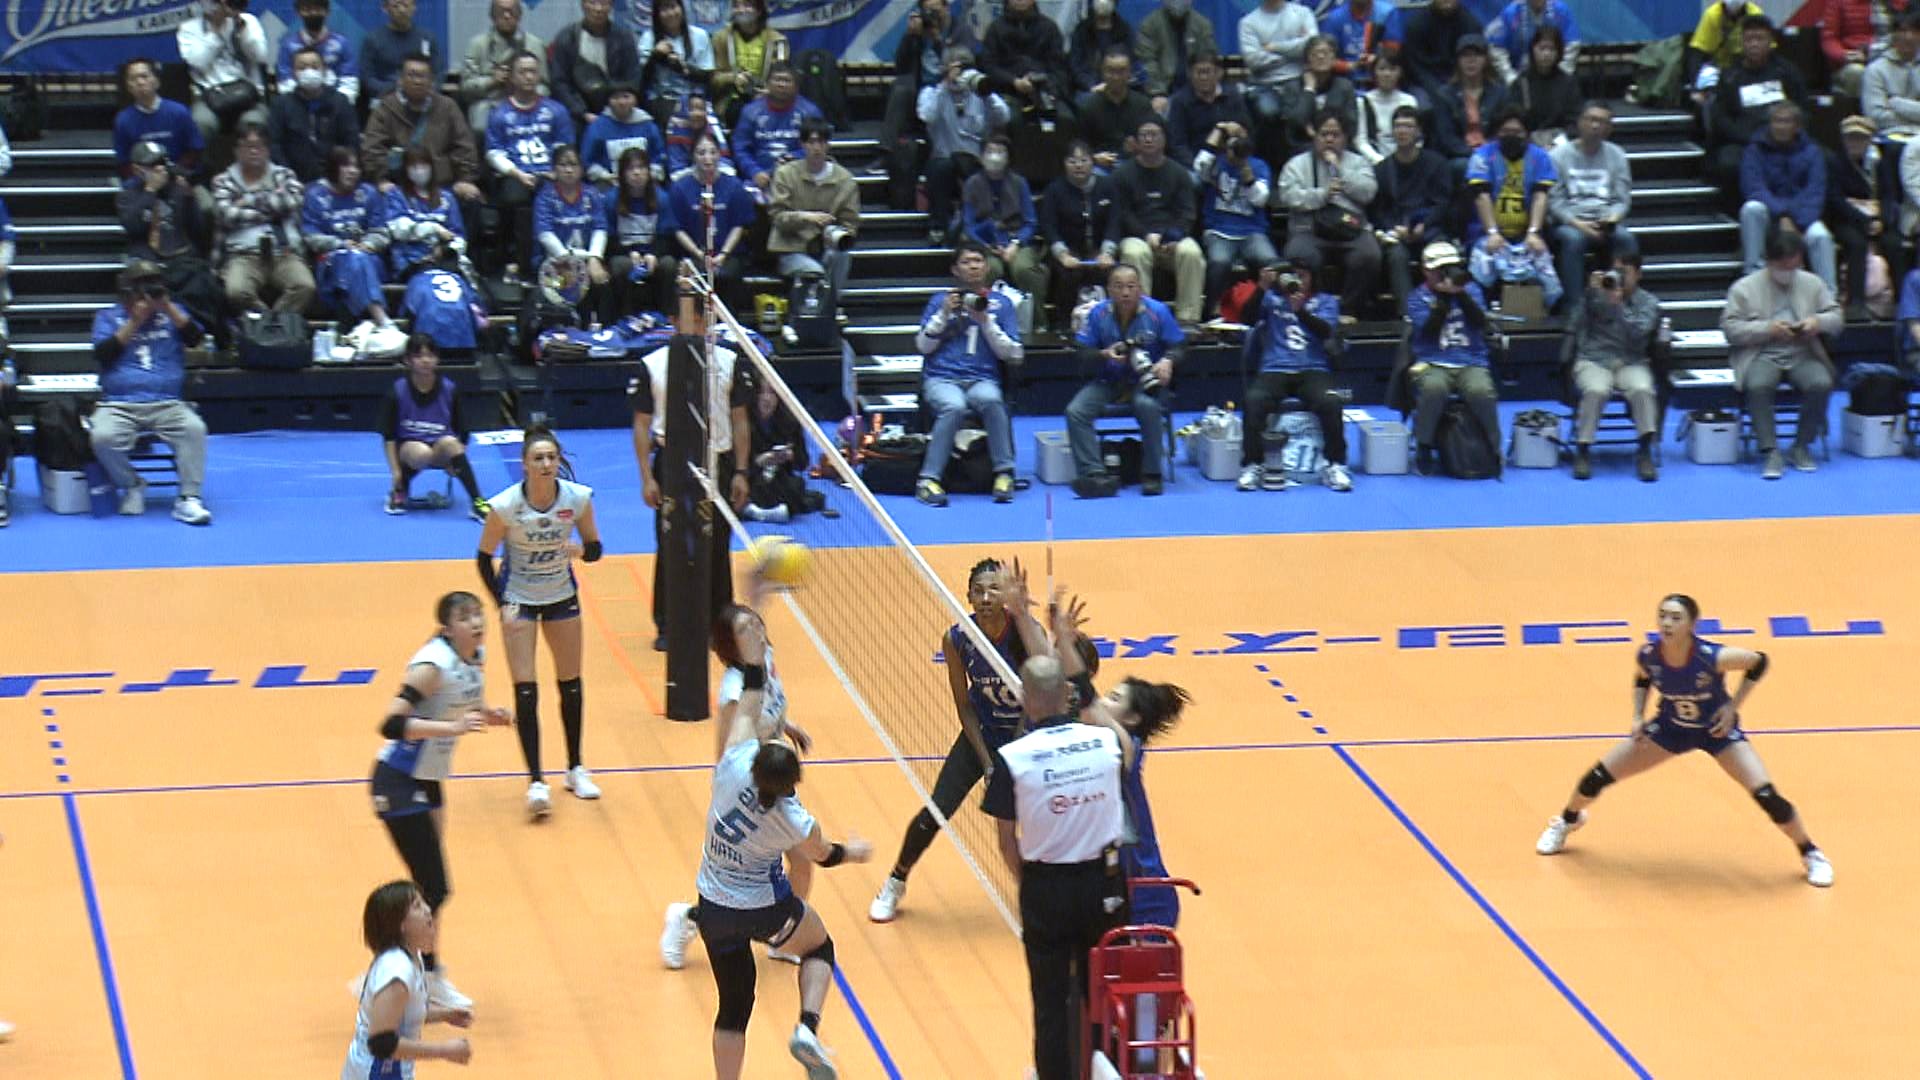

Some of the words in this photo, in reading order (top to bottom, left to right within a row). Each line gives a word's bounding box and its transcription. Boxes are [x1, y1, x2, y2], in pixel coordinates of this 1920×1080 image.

[431, 274, 462, 302] 3
[965, 325, 979, 354] 1
[135, 345, 153, 370] 1
[526, 529, 562, 542] YKK
[1674, 701, 1699, 721] 8
[714, 808, 759, 845] 5
